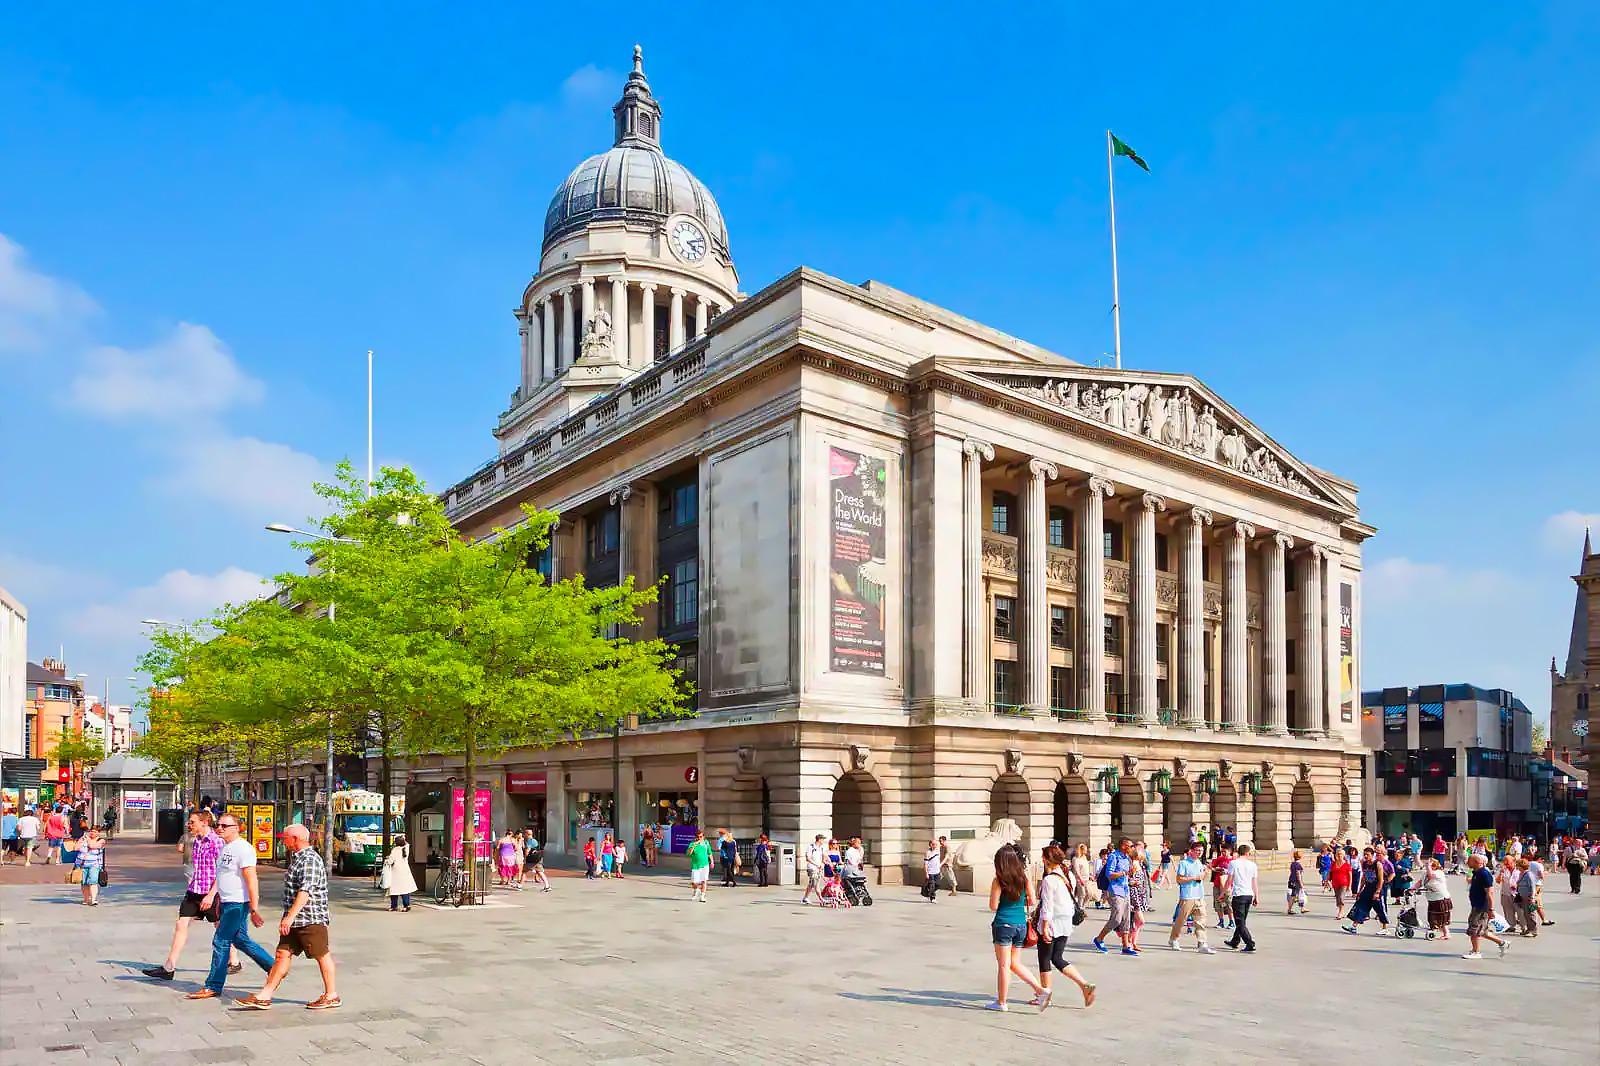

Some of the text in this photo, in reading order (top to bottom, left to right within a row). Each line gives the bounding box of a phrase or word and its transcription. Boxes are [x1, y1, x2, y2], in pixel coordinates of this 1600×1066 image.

[835, 488, 865, 508] Dress
[835, 502, 882, 528] the World
